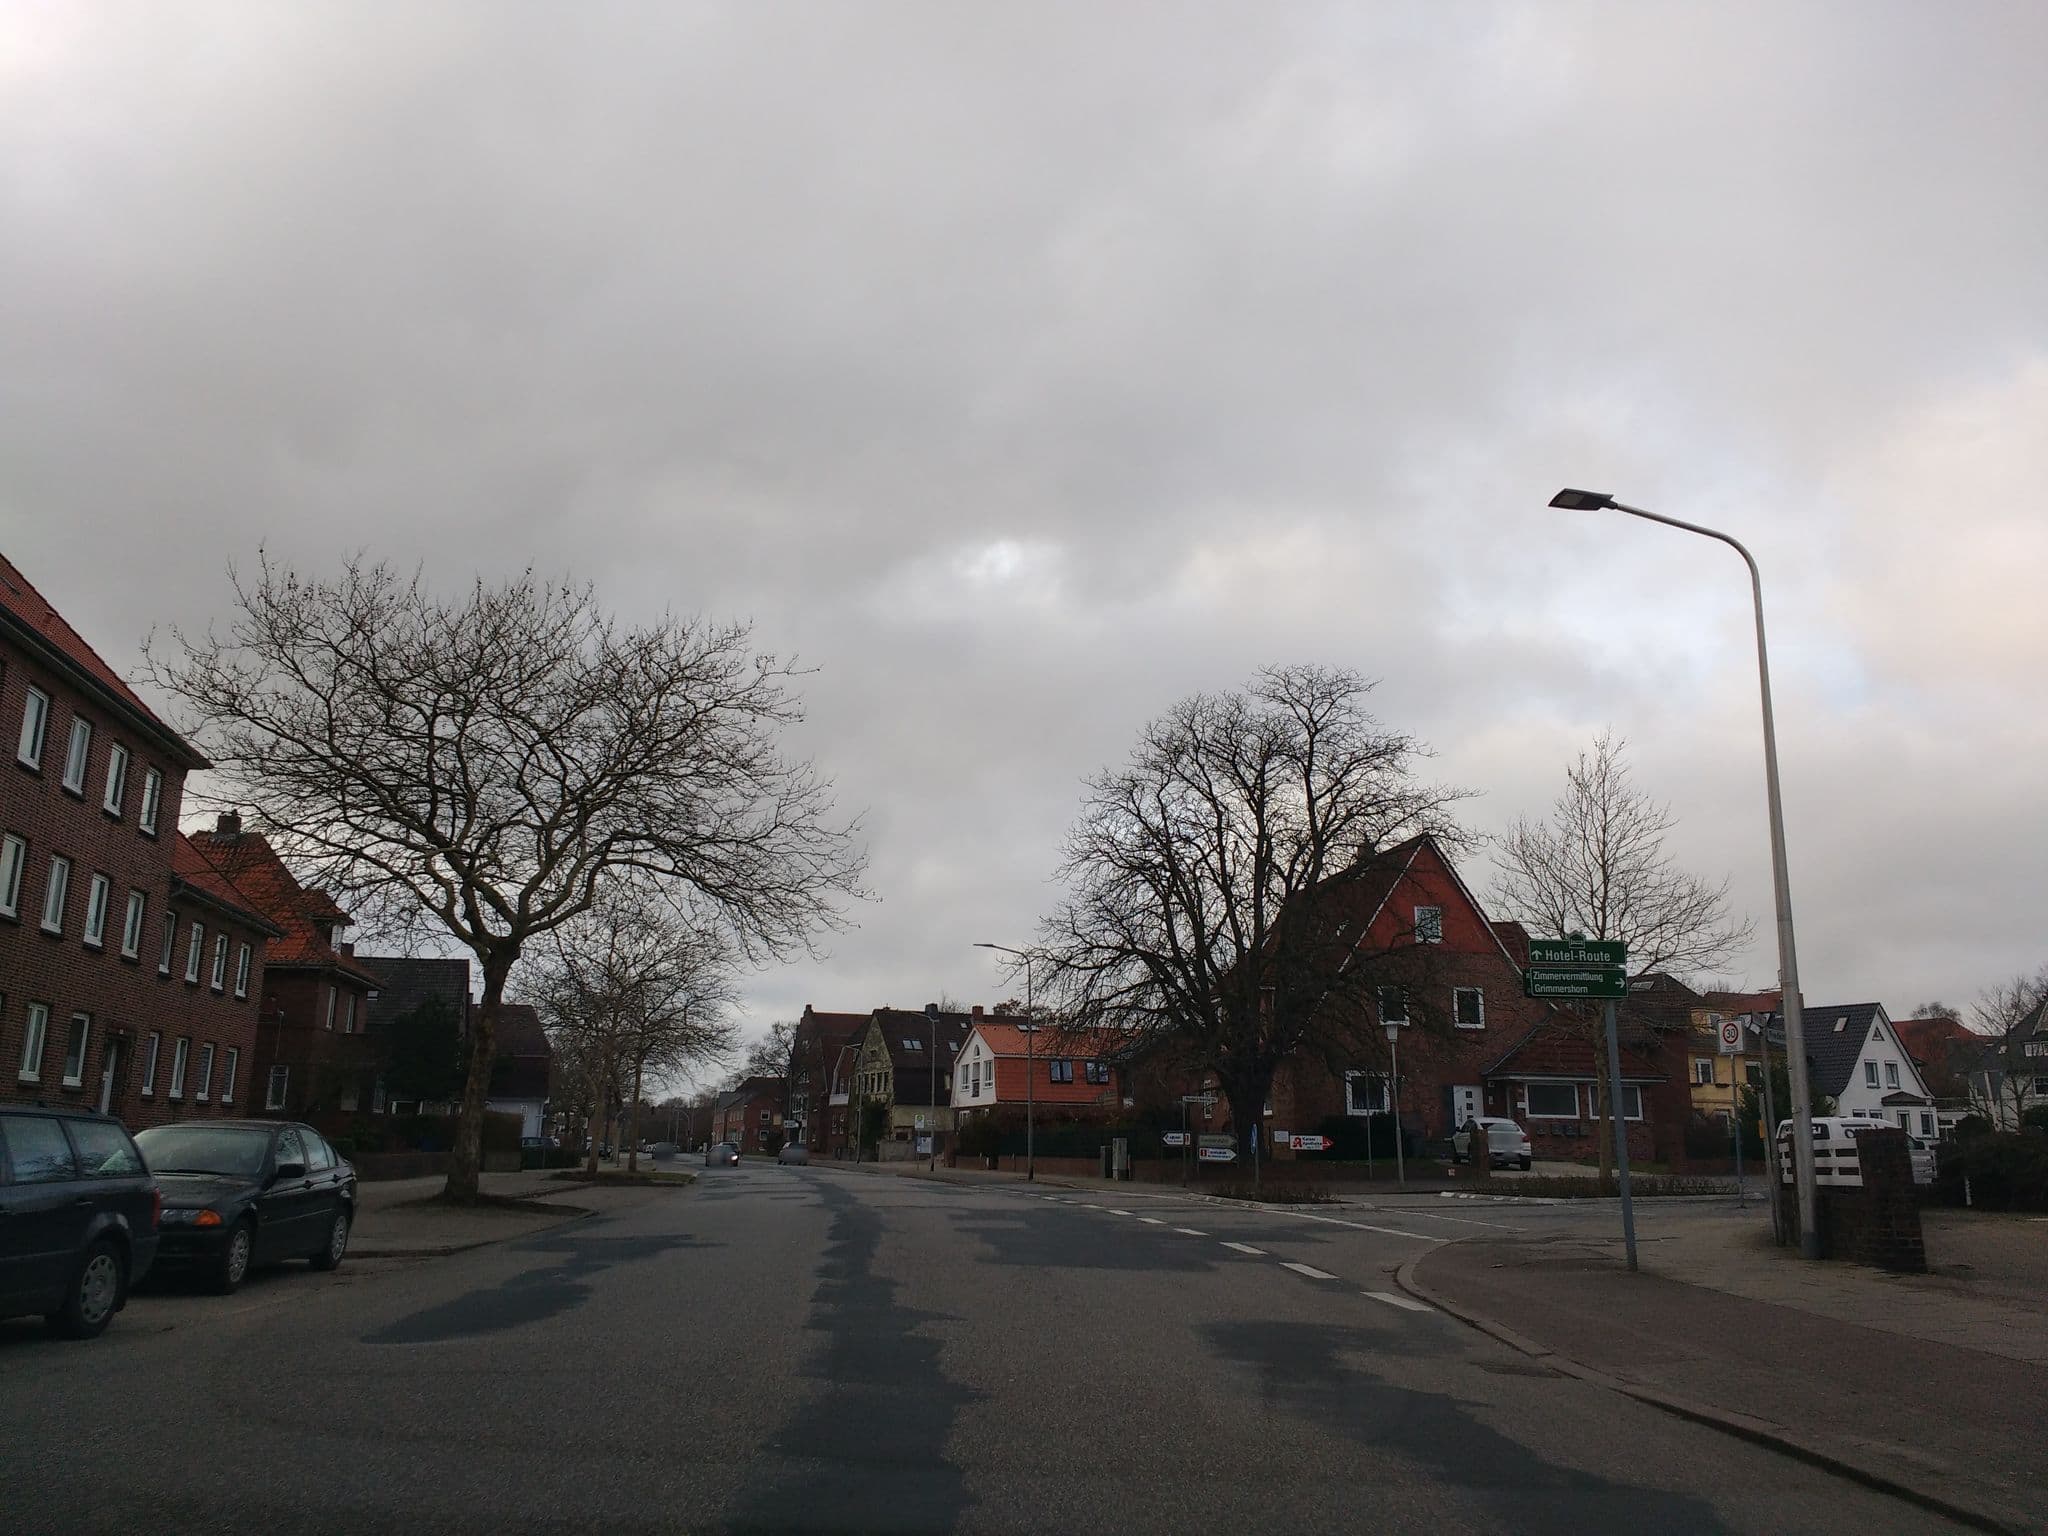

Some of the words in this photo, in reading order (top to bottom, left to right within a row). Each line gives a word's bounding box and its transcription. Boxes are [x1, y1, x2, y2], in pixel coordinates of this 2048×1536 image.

[1545, 949, 1611, 962] Hotel-Route
[1532, 971, 1604, 983] Zimmervermittlung
[1534, 983, 1588, 993] Grimmershorn
[1726, 1028, 1736, 1039] 30
